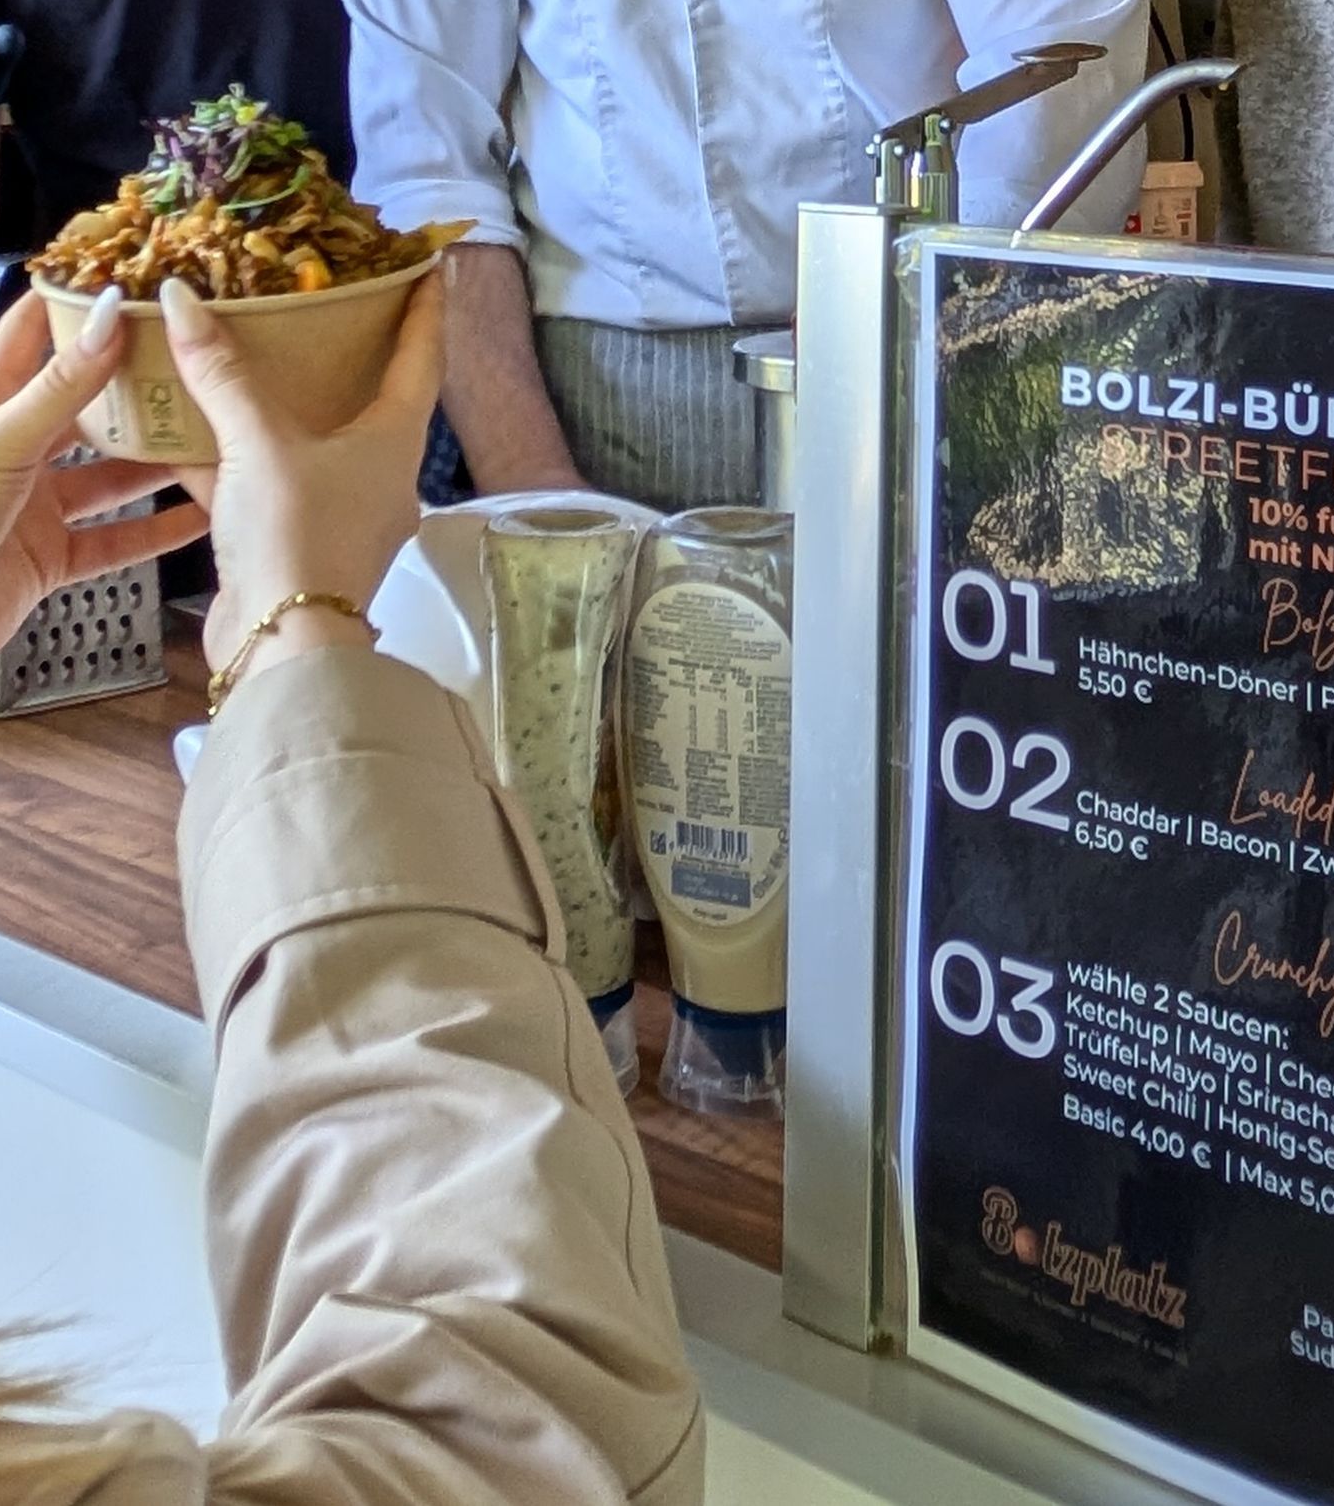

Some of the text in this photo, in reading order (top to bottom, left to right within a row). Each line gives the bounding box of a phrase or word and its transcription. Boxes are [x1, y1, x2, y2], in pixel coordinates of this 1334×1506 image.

[1248, 496, 1309, 532] 10%
[1248, 532, 1303, 569] mit
[941, 567, 1057, 675] 01
[1078, 635, 1298, 703] Hähnchen-Döner
[1078, 666, 1154, 706] 5,50 €
[939, 715, 1071, 832] 02
[1075, 821, 1150, 862] 6,50 €
[1076, 789, 1180, 837] Chaddar
[1200, 820, 1281, 863] Bacon
[929, 939, 1057, 1060] 03
[1065, 991, 1171, 1048] Ketchup
[1189, 1027, 1258, 1077] Mayo
[1067, 961, 1291, 1053] wähle 2 Saucen:
[1062, 1053, 1137, 1104] Sweet
[1142, 1074, 1198, 1122] Chili
[1064, 1020, 1218, 1098] Trüffel-Mayo
[1064, 1094, 1126, 1140] Basic
[1130, 1113, 1186, 1162] 4,00
[1190, 1140, 1213, 1170] €
[1239, 1157, 1295, 1204] Max
